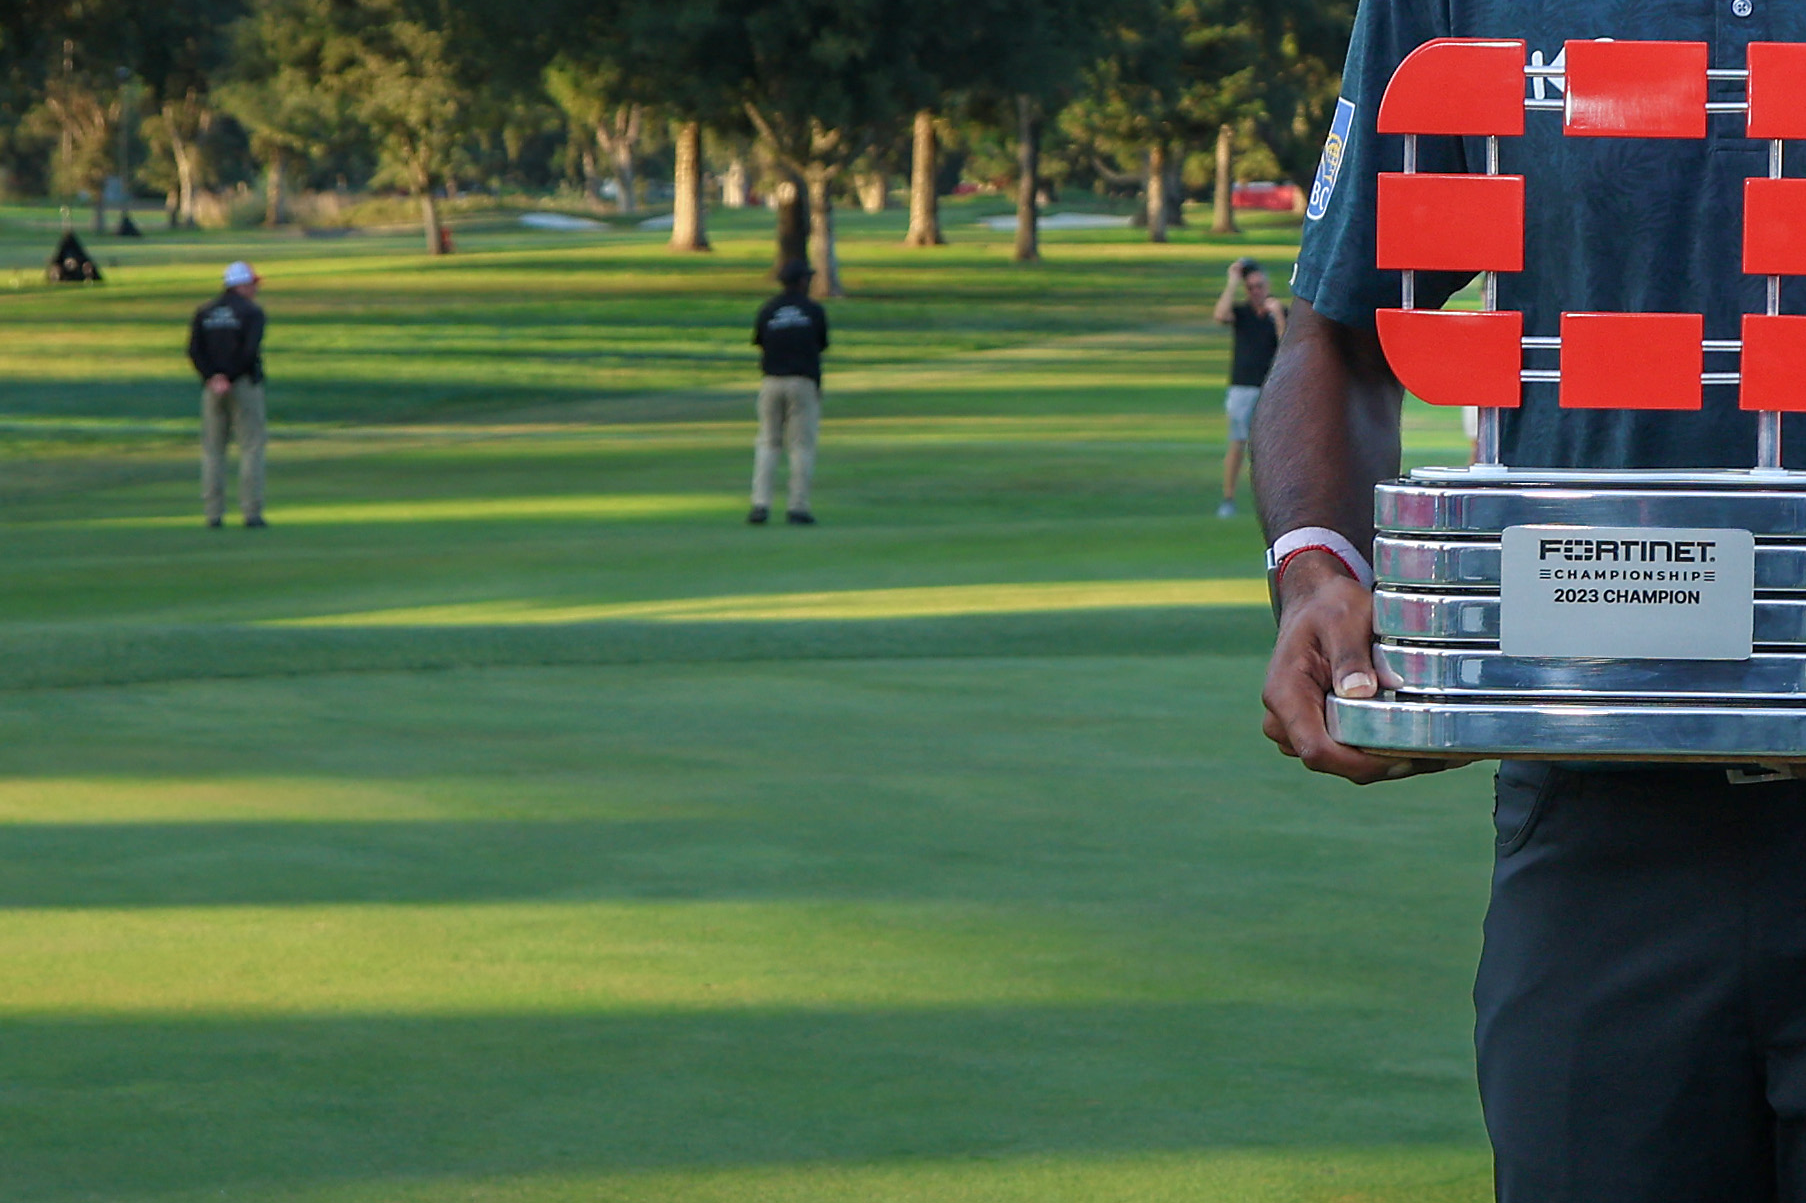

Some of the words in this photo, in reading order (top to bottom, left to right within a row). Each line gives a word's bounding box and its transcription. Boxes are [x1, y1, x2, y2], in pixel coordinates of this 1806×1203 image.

[1539, 539, 1716, 563] FORTINET
[1554, 569, 1702, 582] CHAMPIONSHIP
[1554, 589, 1599, 604] 2023
[1603, 589, 1700, 605] CHAMPION
